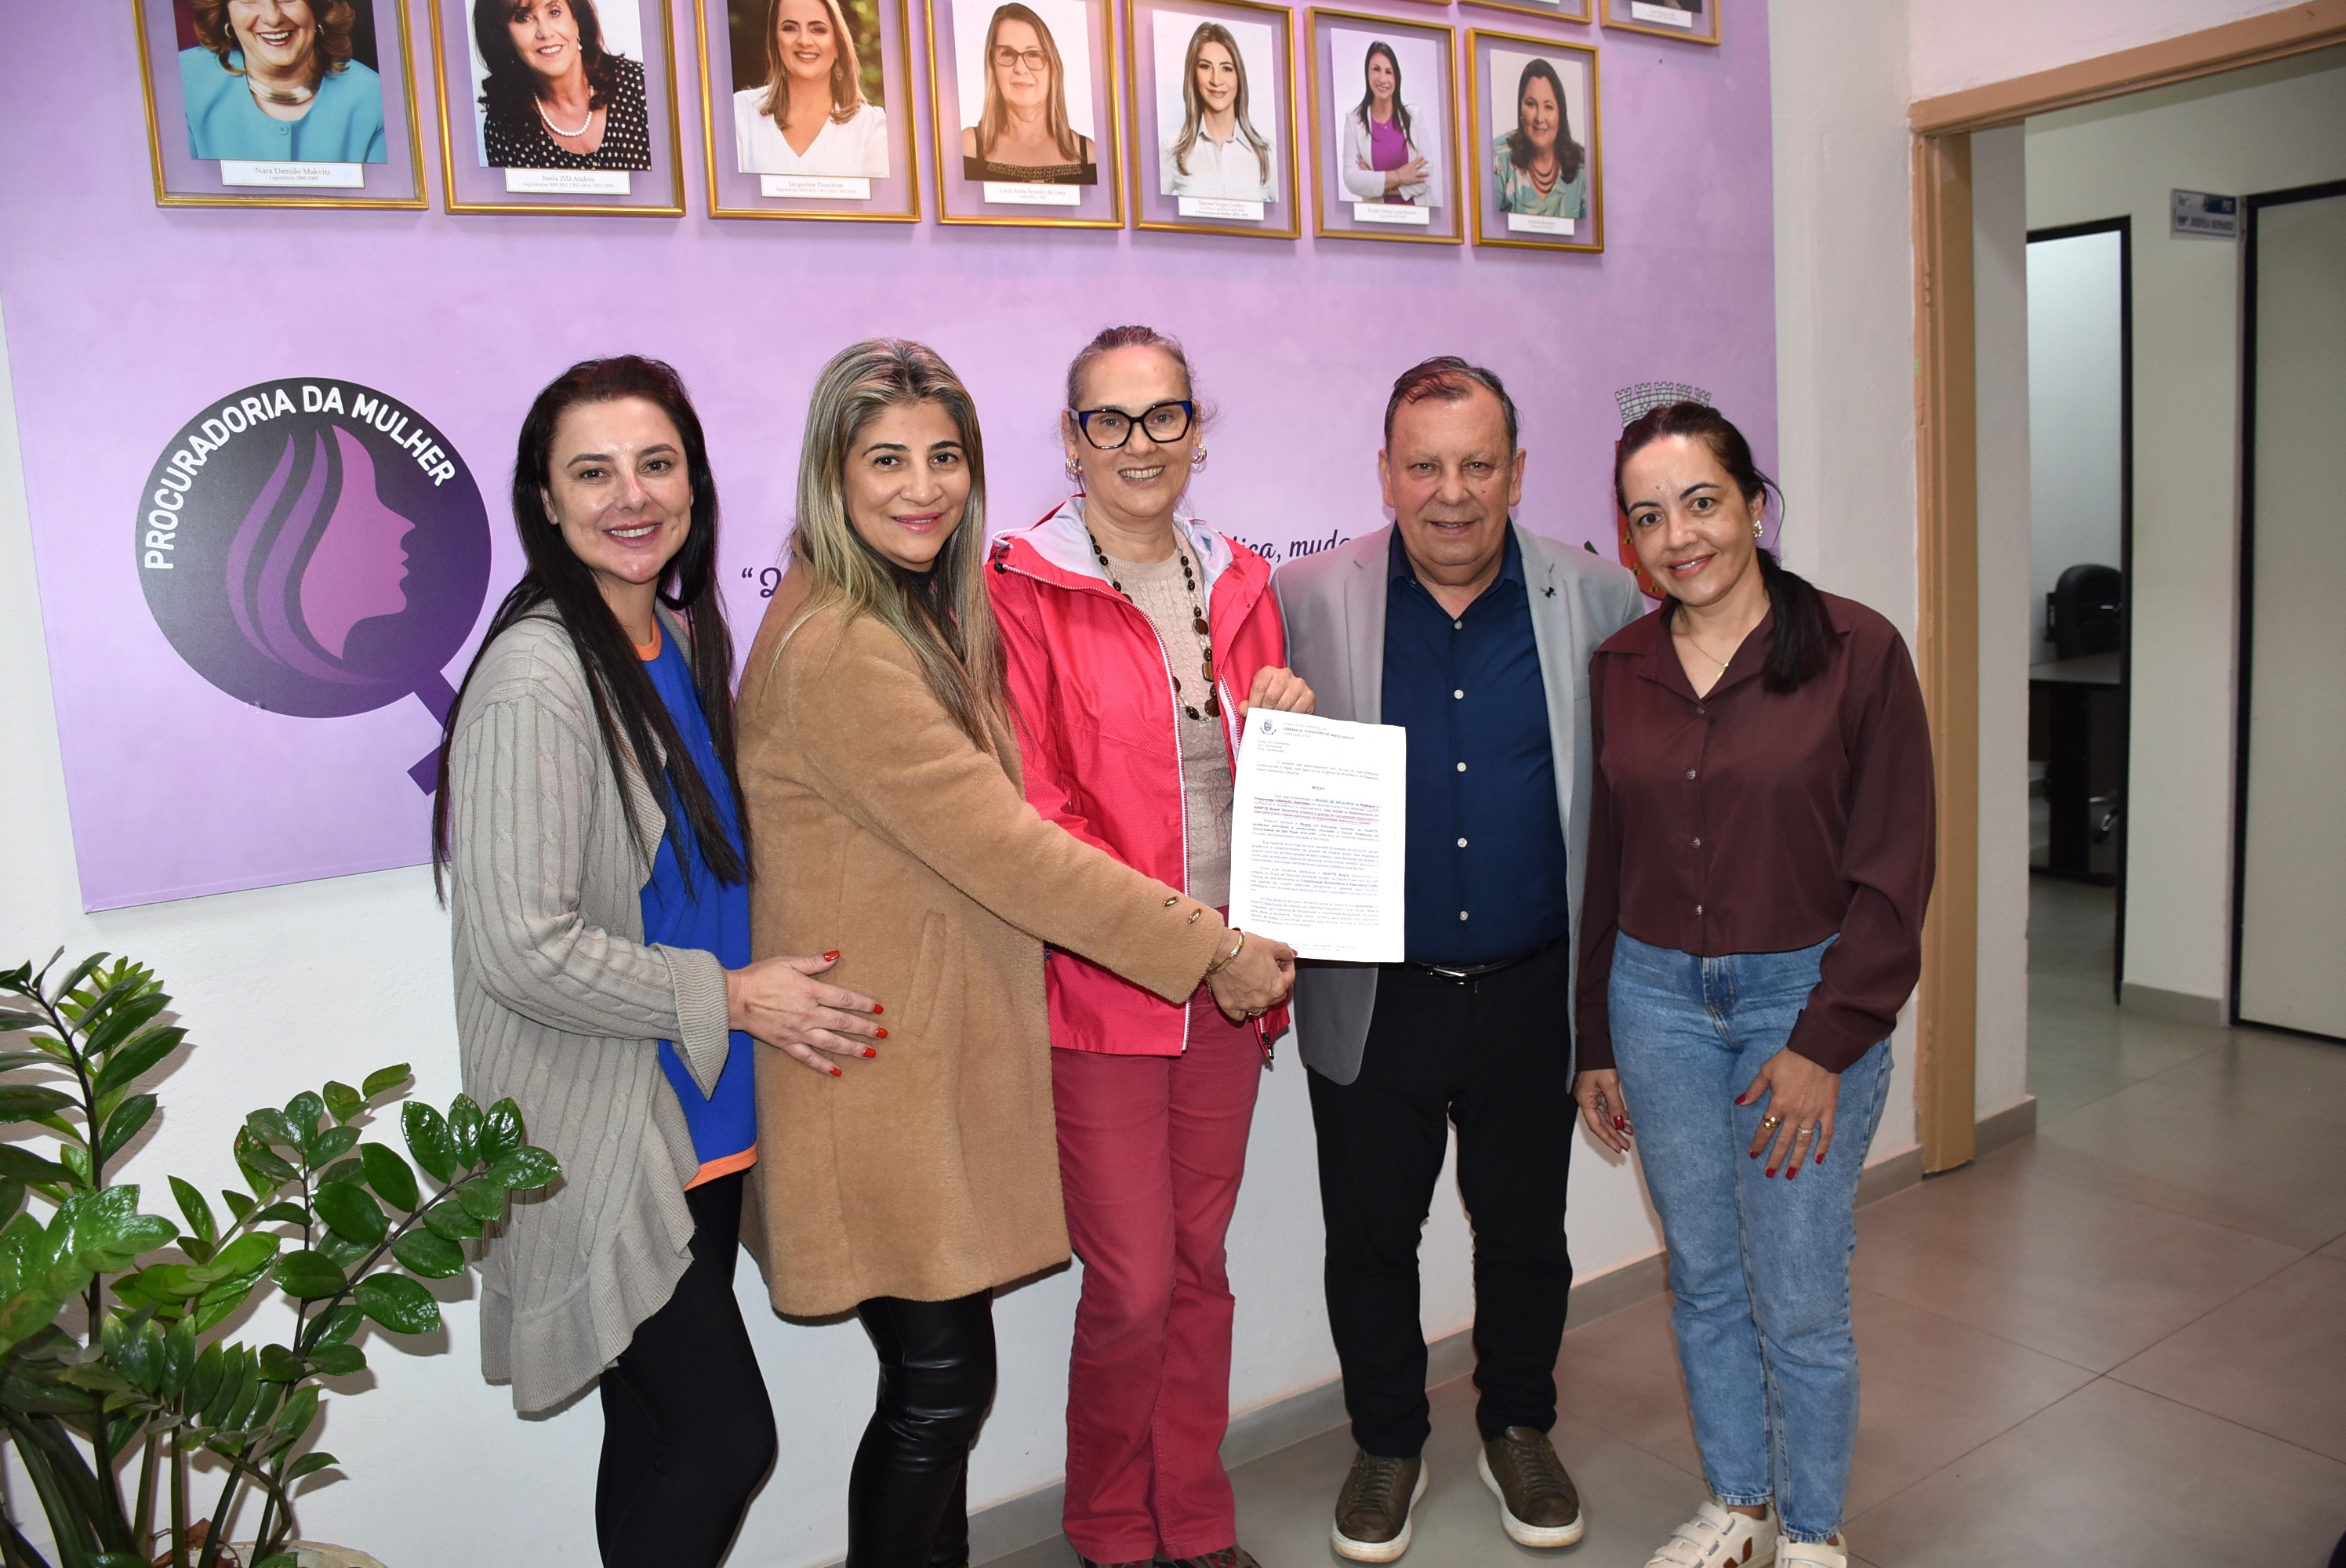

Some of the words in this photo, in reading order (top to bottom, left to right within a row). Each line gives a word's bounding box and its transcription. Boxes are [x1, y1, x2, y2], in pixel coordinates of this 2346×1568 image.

[145, 388, 296, 569] PROCURADORIA
[303, 385, 344, 414] DA
[352, 393, 456, 487] MULHER
